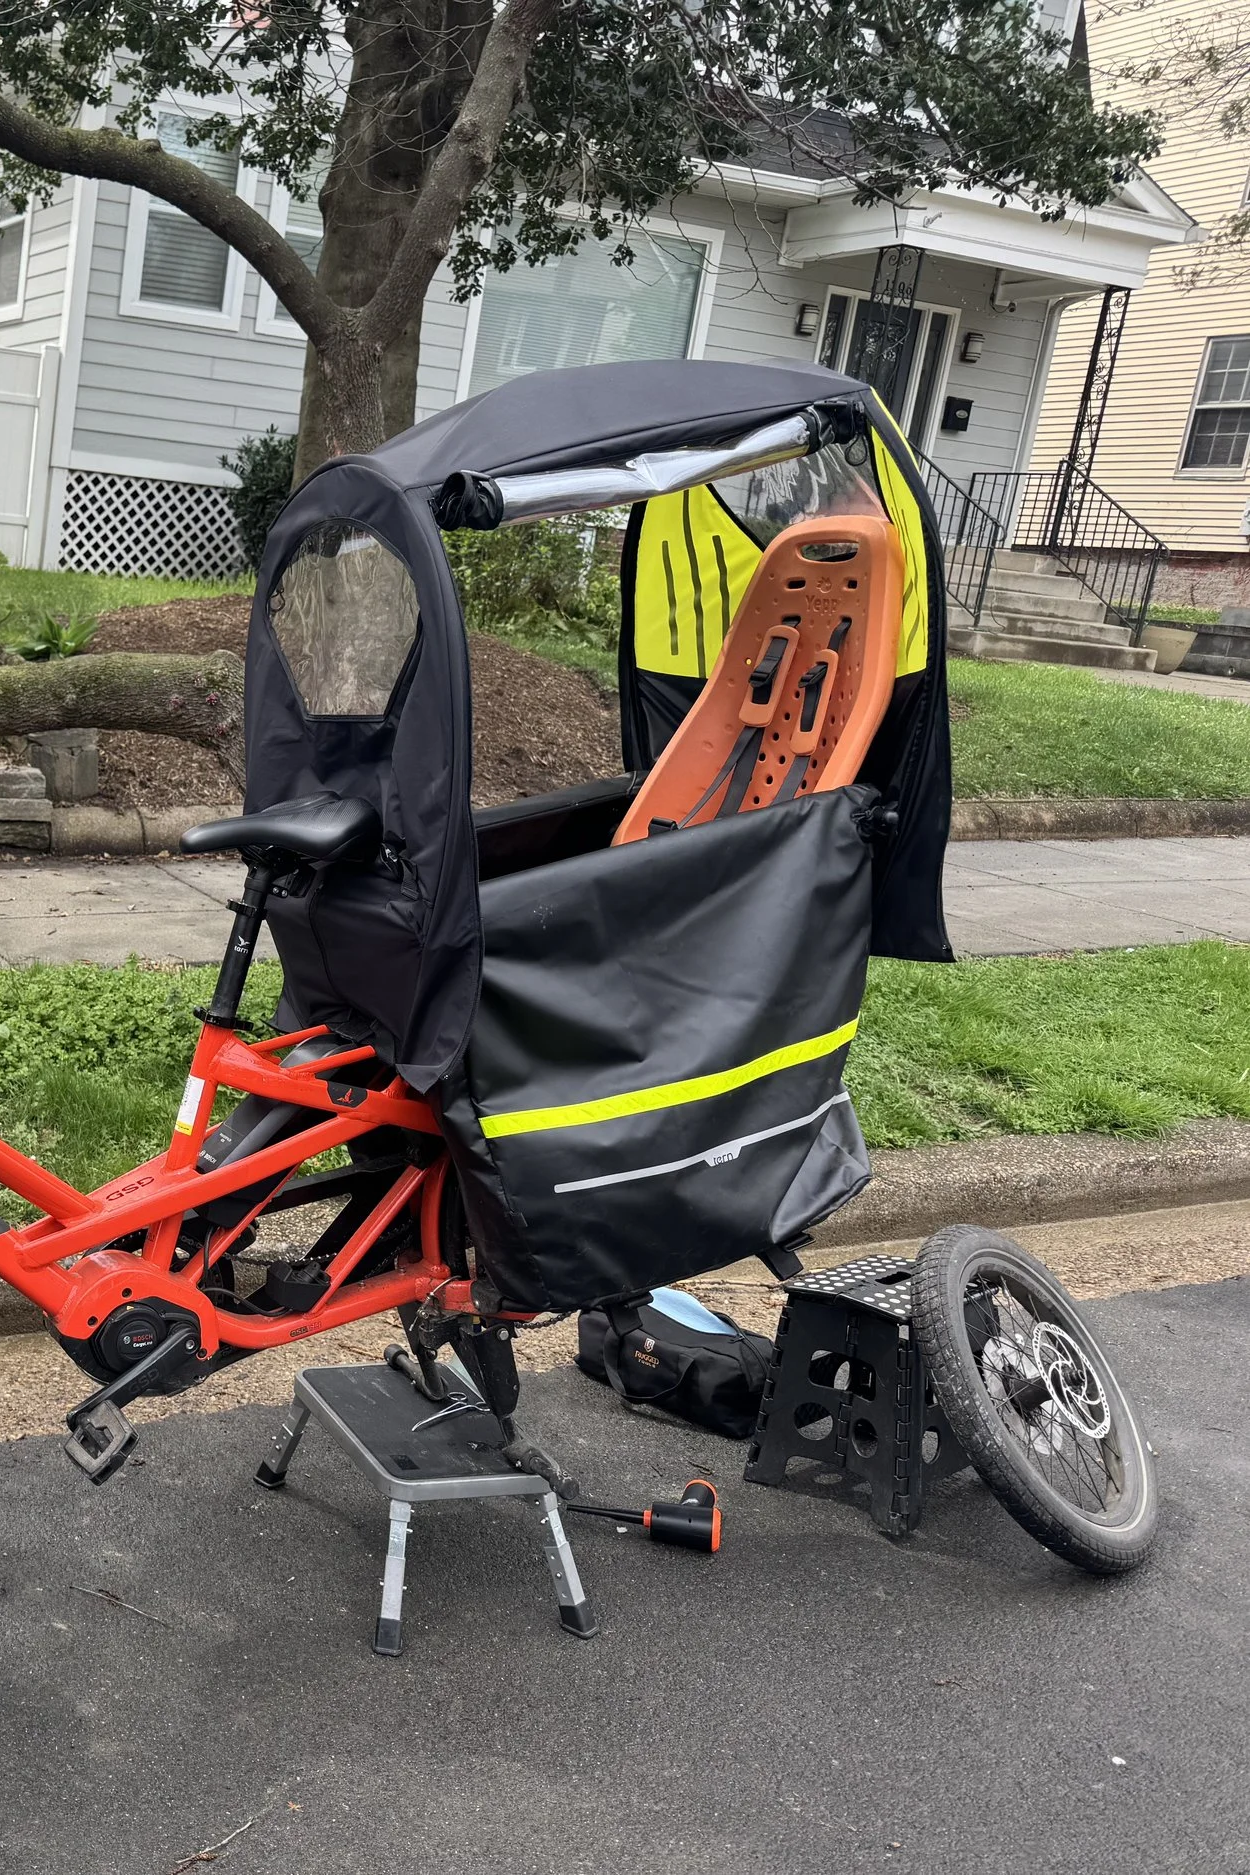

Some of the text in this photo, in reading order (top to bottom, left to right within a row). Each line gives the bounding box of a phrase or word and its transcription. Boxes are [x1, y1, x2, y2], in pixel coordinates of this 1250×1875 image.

[805, 594, 838, 616] Yepp
[713, 1152, 734, 1166] tern
[105, 1176, 155, 1202] GSD
[132, 1333, 154, 1342] BOSCH
[634, 1350, 659, 1365] RUGGED
[129, 1368, 160, 1395] GSD
